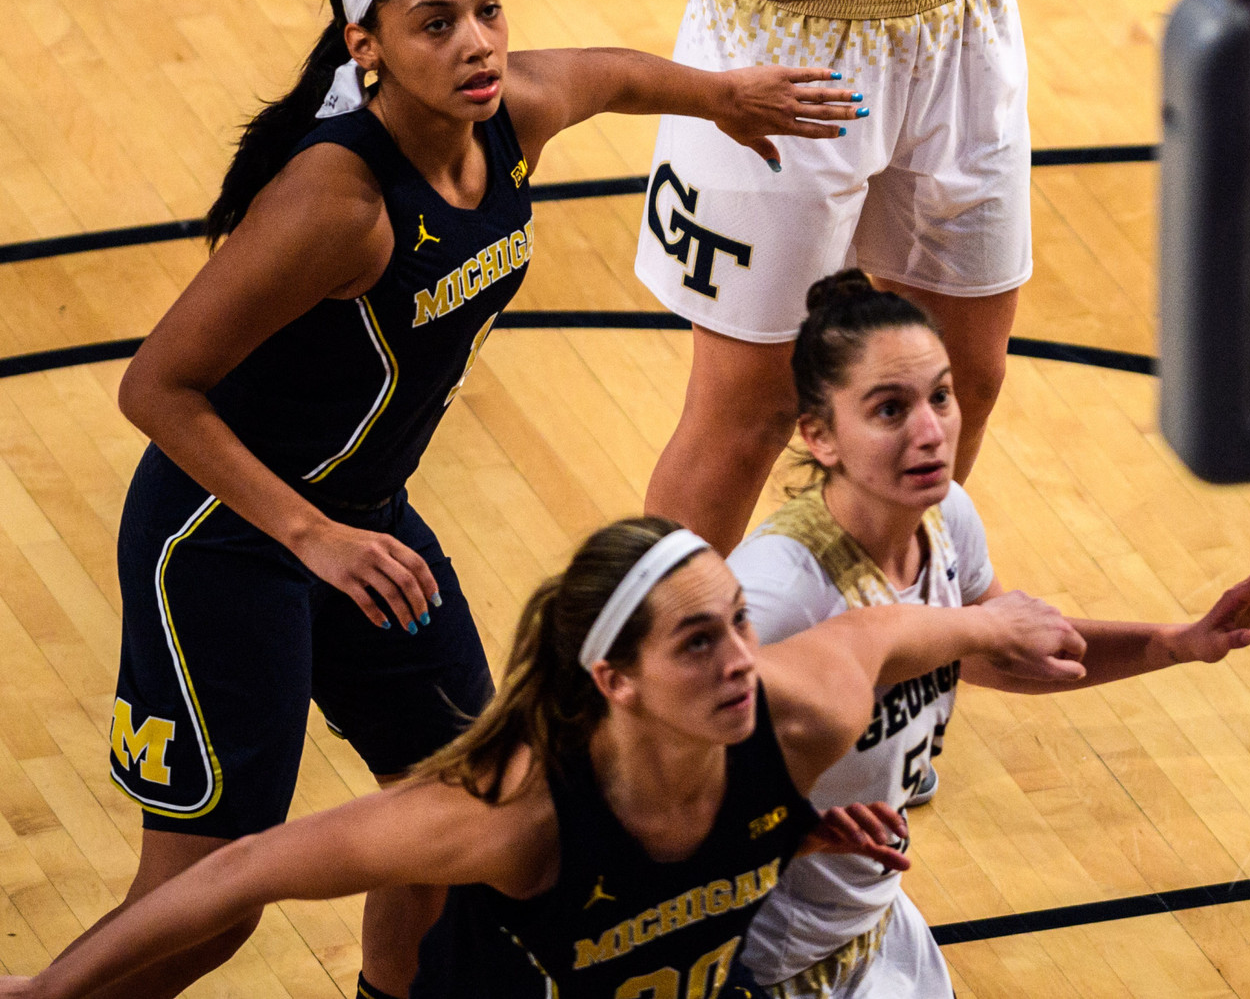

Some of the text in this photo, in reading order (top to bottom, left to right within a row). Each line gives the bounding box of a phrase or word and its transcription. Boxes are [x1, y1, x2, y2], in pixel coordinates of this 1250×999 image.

[412, 214, 535, 328] MICHIGA
[111, 696, 176, 787] M
[573, 856, 782, 971] MICHIGAN
